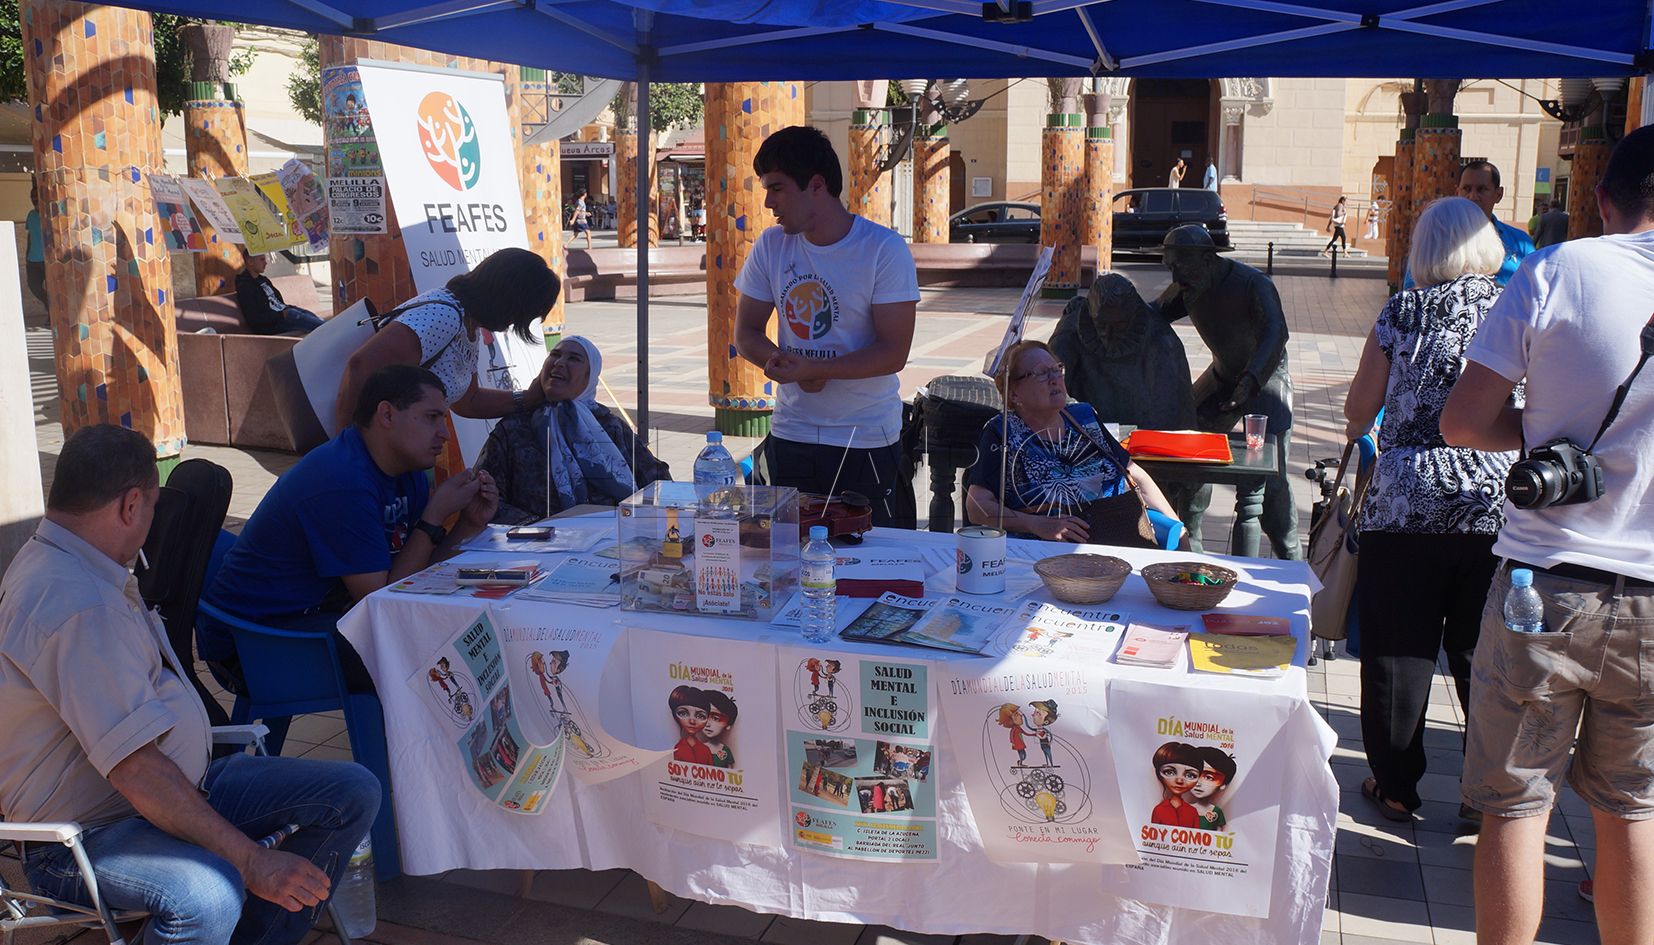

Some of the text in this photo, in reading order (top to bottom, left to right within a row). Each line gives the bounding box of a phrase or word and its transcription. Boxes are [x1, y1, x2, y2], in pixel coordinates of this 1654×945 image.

[424, 203, 507, 234] FEAFES
[421, 250, 456, 268] SALUD
[798, 273, 812, 281] POR
[830, 295, 840, 322] MENTAL
[982, 557, 1006, 569] FEA
[885, 594, 937, 608] encue
[946, 598, 1015, 616] encuen
[1027, 602, 1120, 621] encuentro
[1020, 612, 1115, 633] encuentro
[463, 622, 484, 647] SALUD
[468, 632, 492, 660] MENTAL
[483, 652, 489, 662] E
[669, 661, 691, 681] DÍA
[691, 666, 720, 678] MUNDIAL
[875, 666, 912, 679] SALUD
[709, 677, 733, 685] MENTAL
[871, 680, 917, 694] MENTAL
[891, 696, 898, 706] E
[864, 706, 925, 722] INCLUSIÓN
[874, 721, 916, 735] SOCIAL
[1157, 716, 1183, 737] DÍA
[1184, 721, 1220, 733] MUNDIAL
[1185, 730, 1235, 741] Salud MENTAL
[668, 762, 744, 785] SOY COMO TÚ
[1040, 826, 1050, 834] EN
[1141, 825, 1235, 849] SOY COMO TÚ
[1142, 840, 1170, 851] aunque
[1172, 844, 1187, 854] aún
[1209, 850, 1232, 858] sepas
